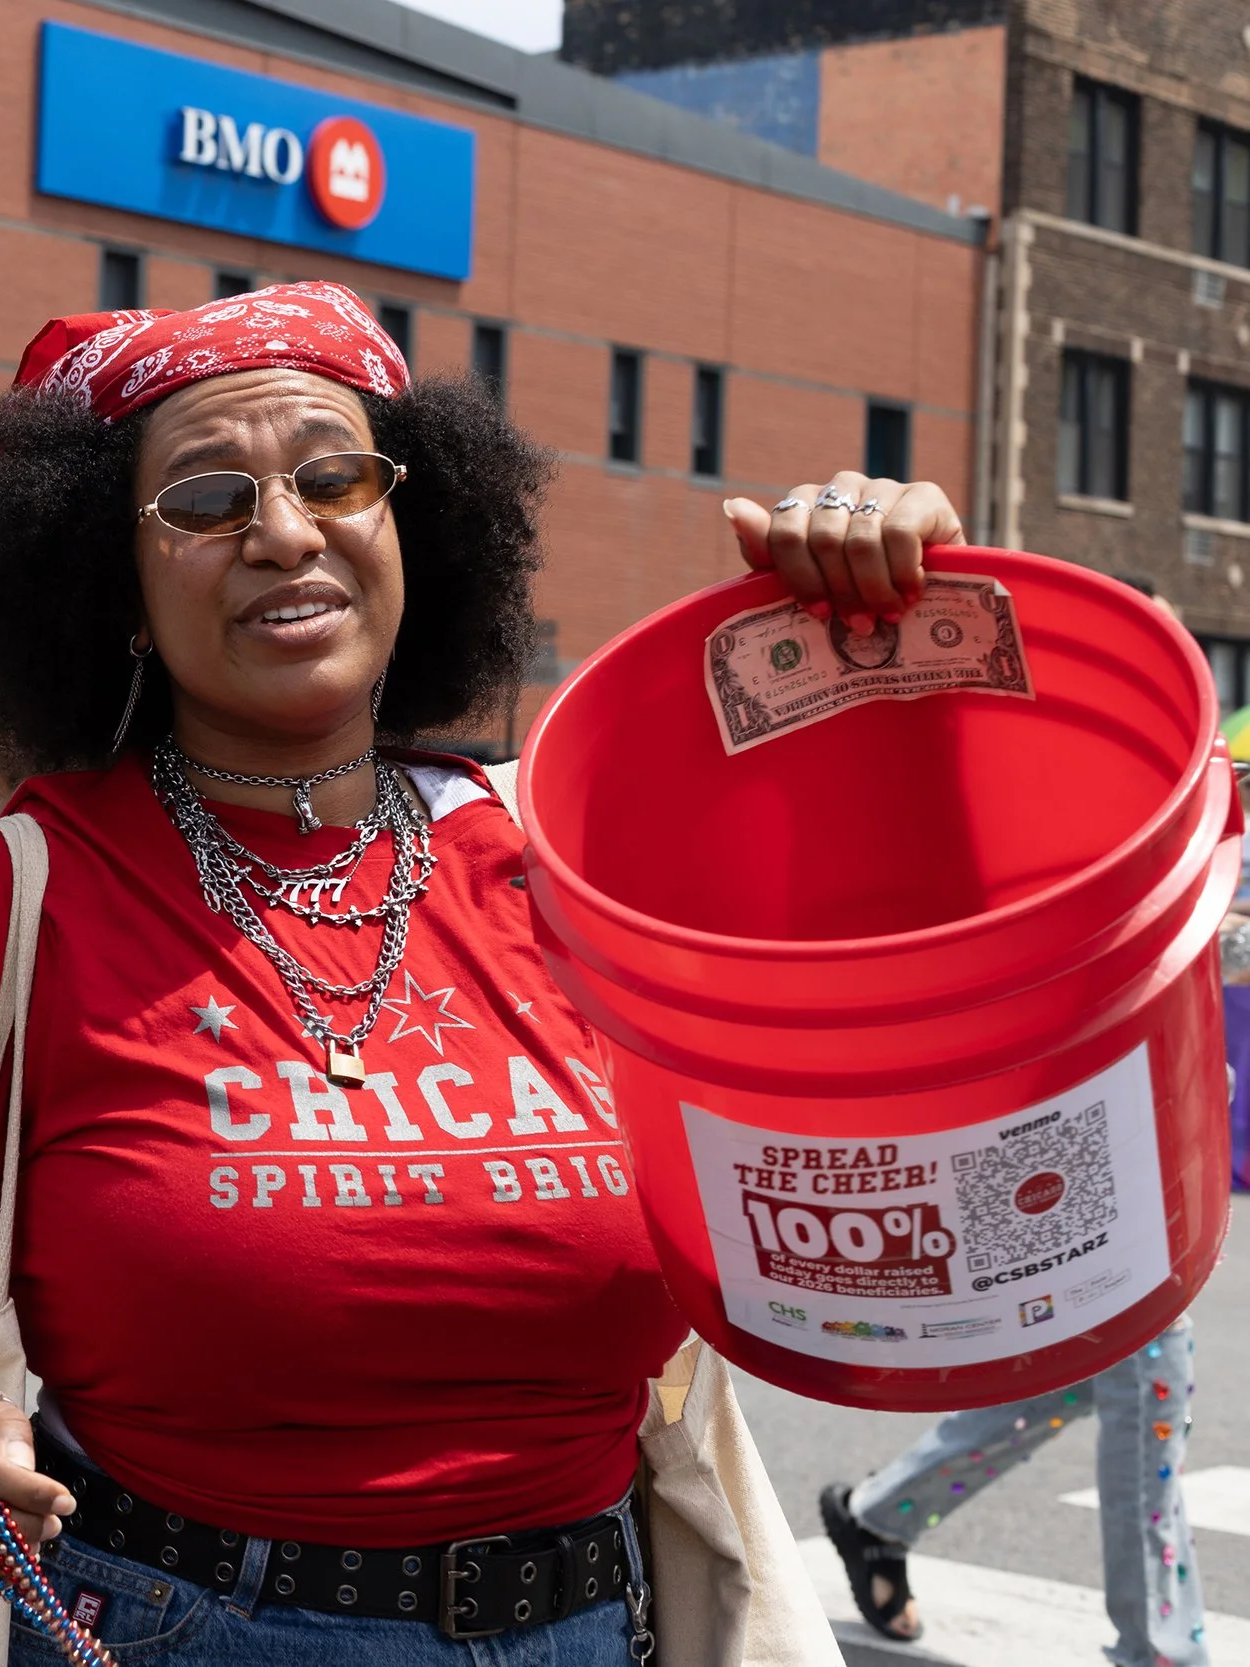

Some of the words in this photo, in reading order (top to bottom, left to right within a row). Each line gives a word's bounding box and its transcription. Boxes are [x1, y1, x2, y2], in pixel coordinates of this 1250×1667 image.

[180, 105, 303, 184] BMO
[281, 877, 347, 902] 777
[999, 1110, 1061, 1140] venmo
[762, 1144, 898, 1170] SPREAD
[209, 1163, 444, 1209] SPIRIT
[483, 1154, 630, 1204] BRIG
[734, 1163, 798, 1193] THE
[812, 1161, 937, 1195] CHEER!
[748, 1200, 949, 1262] 100%
[770, 1261, 811, 1278] today
[815, 1273, 852, 1286] goes
[856, 1275, 917, 1288] directly
[920, 1276, 939, 1286] to
[771, 1252, 786, 1263] of
[789, 1256, 831, 1274] every
[834, 1265, 880, 1277] dollar
[884, 1265, 934, 1276] raised
[972, 1232, 1109, 1293] @CSBSTARZ
[769, 1271, 795, 1283] our
[797, 1277, 833, 1292] 2026
[836, 1283, 944, 1296] beneficiaries.
[768, 1301, 807, 1321] CHS
